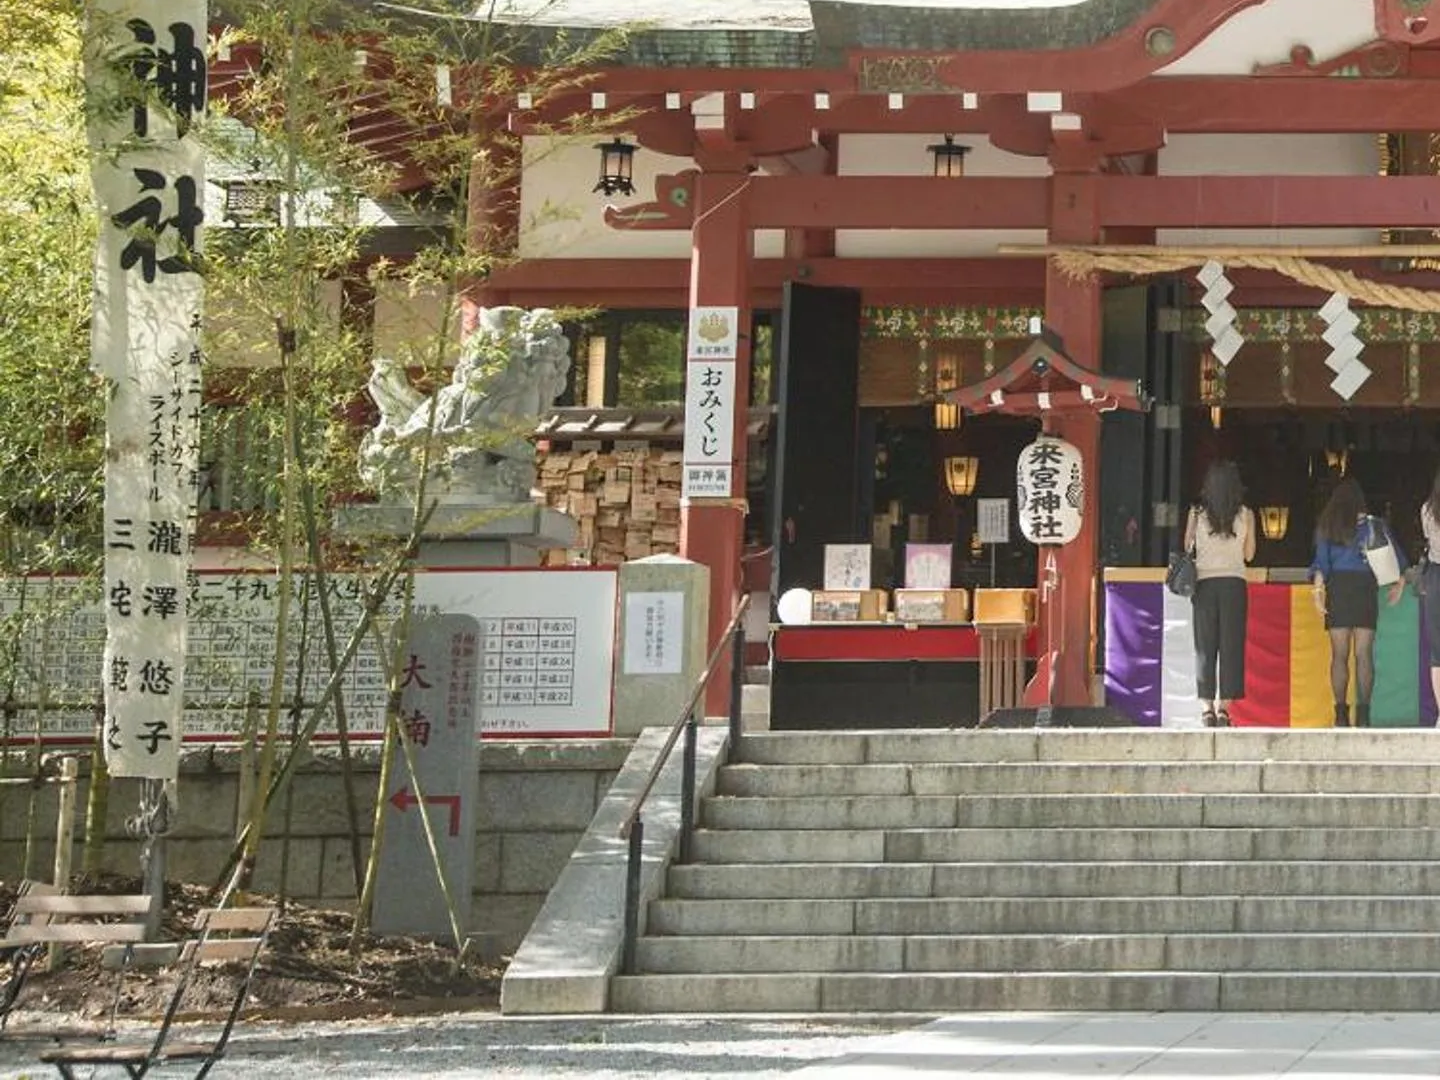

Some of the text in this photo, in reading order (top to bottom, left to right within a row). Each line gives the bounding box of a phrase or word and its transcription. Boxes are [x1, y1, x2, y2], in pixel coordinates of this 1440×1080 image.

[148, 395, 166, 502] ライスボール
[169, 351, 184, 488] シーサイドカフェ
[699, 367, 723, 457] おみくじ
[1028, 443, 1064, 538] 来宮神社
[137, 520, 182, 754] 瀧澤悠子
